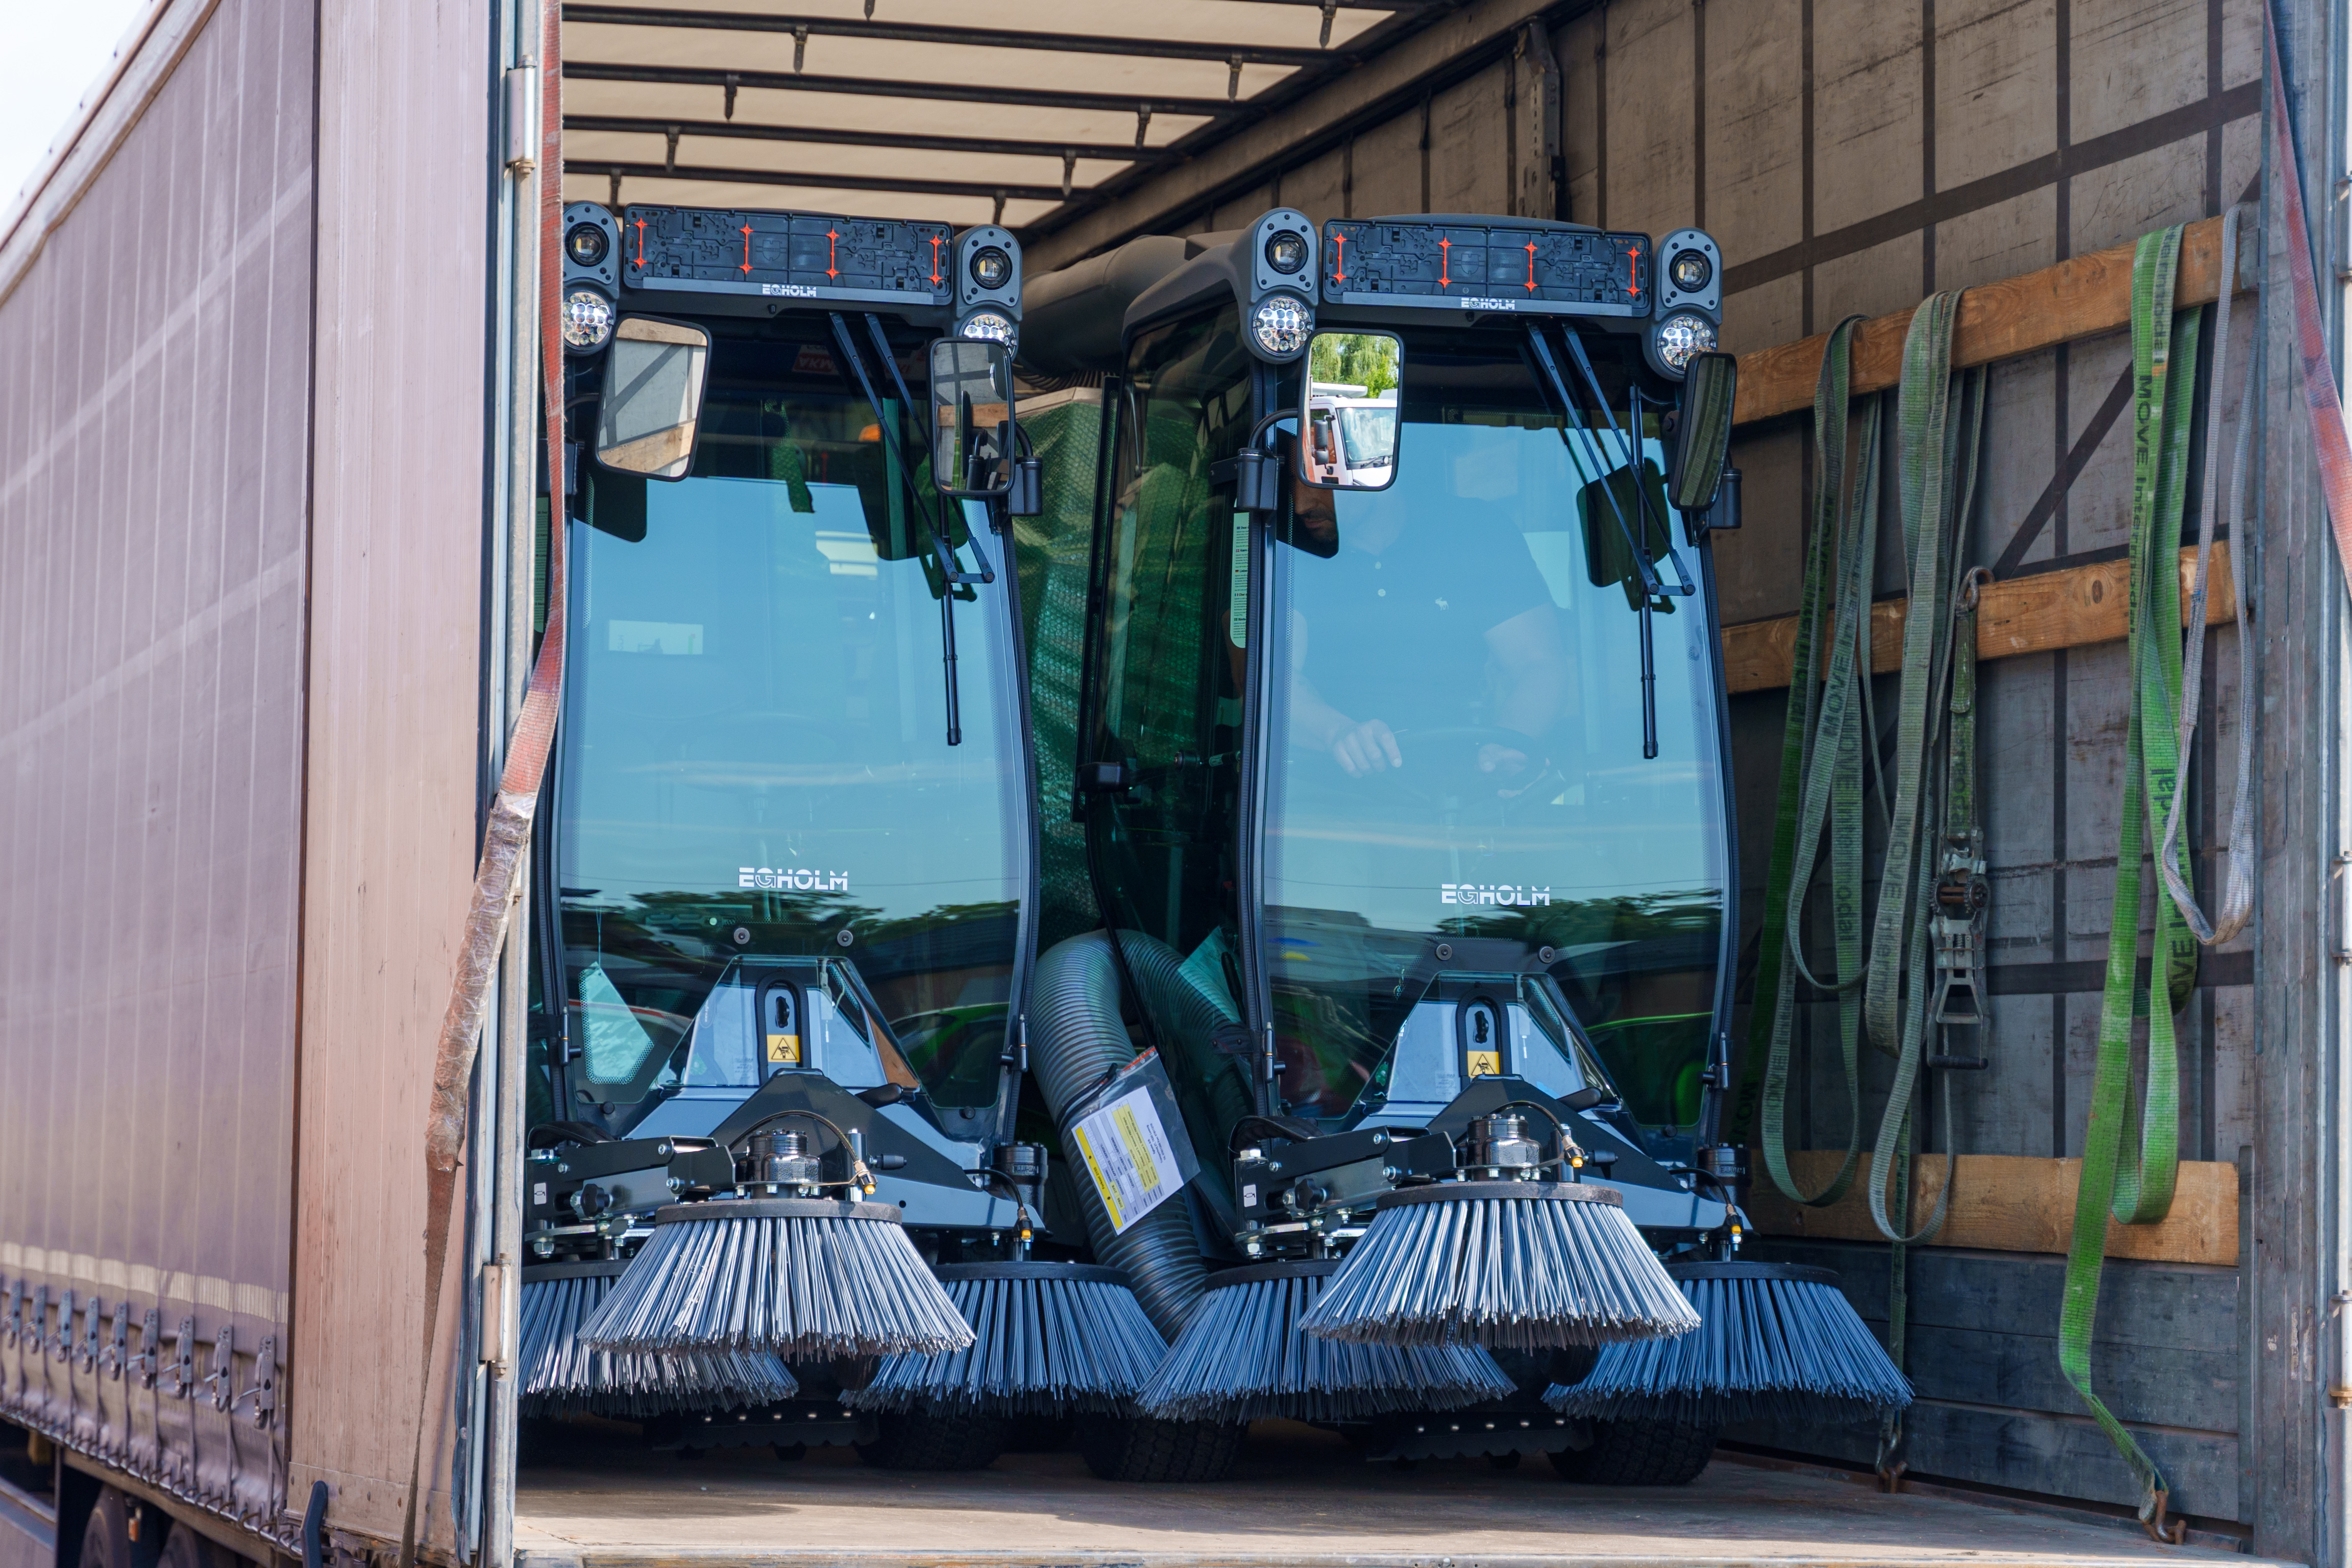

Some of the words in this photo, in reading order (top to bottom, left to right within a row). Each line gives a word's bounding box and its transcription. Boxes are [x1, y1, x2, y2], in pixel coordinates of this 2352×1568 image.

[762, 283, 817, 298] EGHOLM
[1461, 297, 1515, 310] EGHOLM
[2136, 375, 2152, 466] MOVE
[2129, 477, 2147, 634] Intermodal
[1819, 655, 1849, 736] MOVE
[739, 867, 848, 891] EGHOLM
[1883, 818, 1910, 900] MOVE
[1441, 884, 1550, 905] EGHOLM
